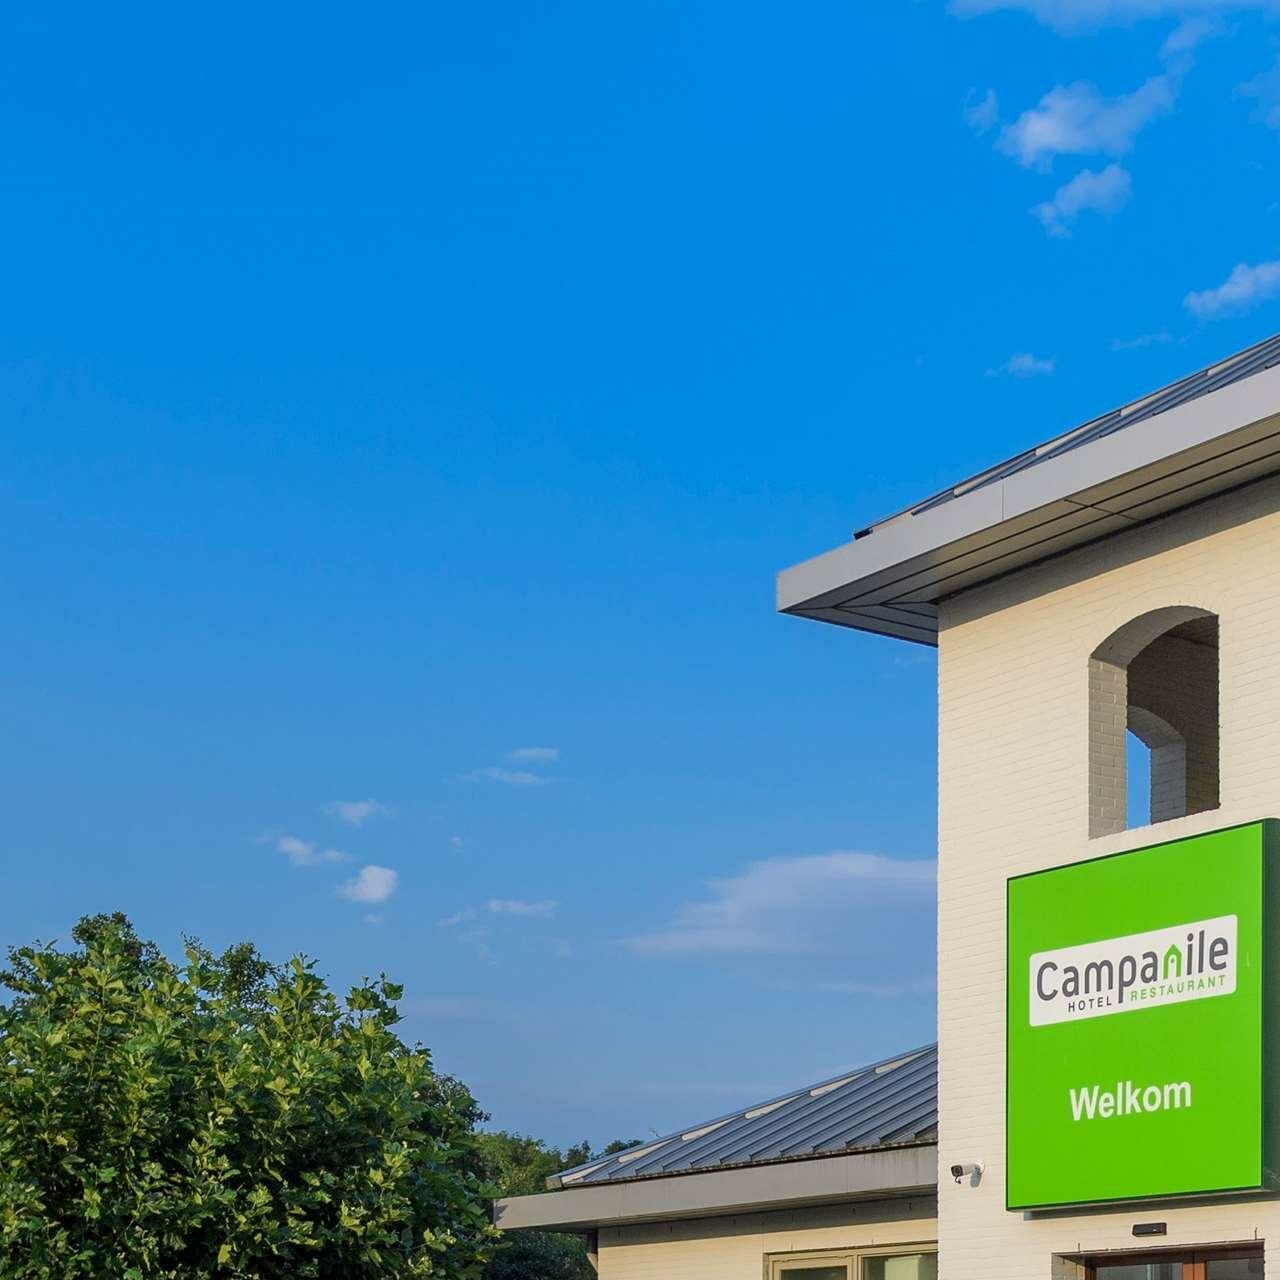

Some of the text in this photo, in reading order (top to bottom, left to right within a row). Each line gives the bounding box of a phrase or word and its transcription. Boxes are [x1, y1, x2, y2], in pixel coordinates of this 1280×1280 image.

[1037, 930, 1229, 1004] Campanile
[1068, 974, 1226, 1013] HOTEL RESTAURANT
[1070, 1080, 1192, 1122] Welkom
